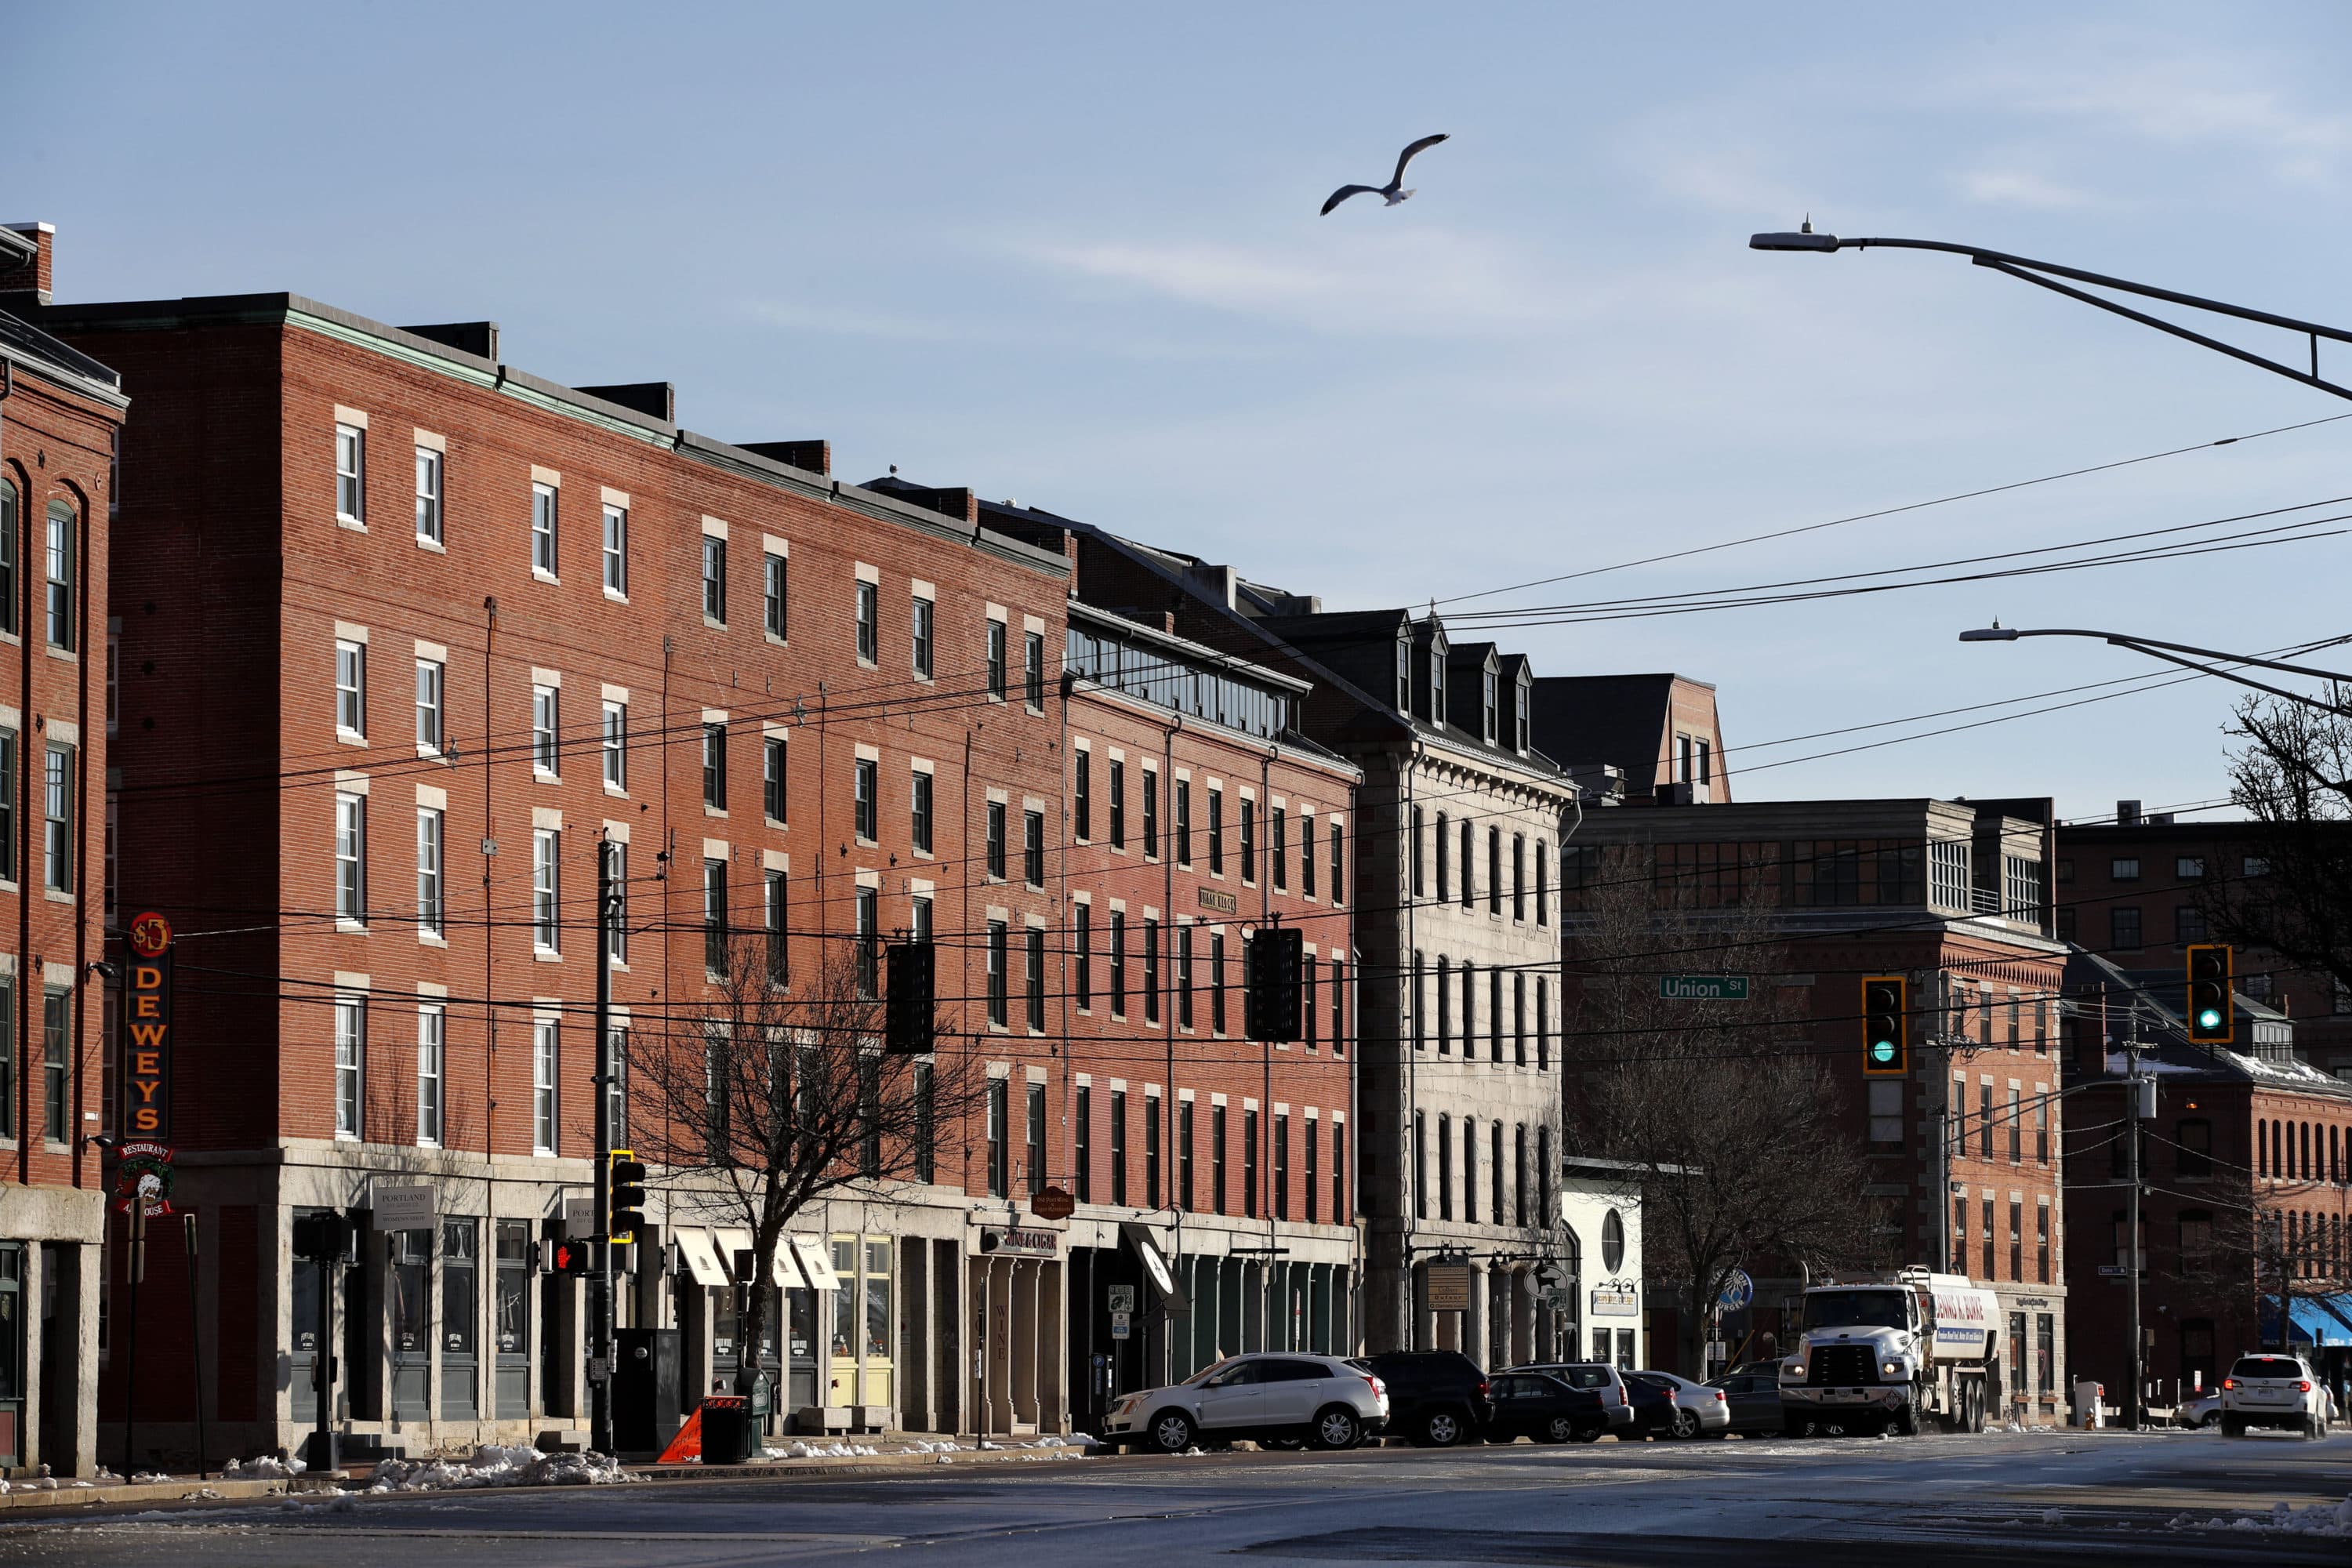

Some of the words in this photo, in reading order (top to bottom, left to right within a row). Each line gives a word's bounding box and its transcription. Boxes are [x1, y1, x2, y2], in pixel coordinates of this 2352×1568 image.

[133, 919, 168, 950] $3
[1665, 979, 1720, 996] Union
[1730, 981, 1741, 990] St
[129, 967, 167, 1131] DEWEYS
[122, 1143, 169, 1157] RESTAURANT
[383, 1194, 426, 1203] PORTLAND
[144, 1204, 163, 1216] OUSE
[1711, 1268, 1748, 1287] ELEVTION
[1963, 1295, 1984, 1320] BURKE
[996, 1305, 1007, 1360] WINE
